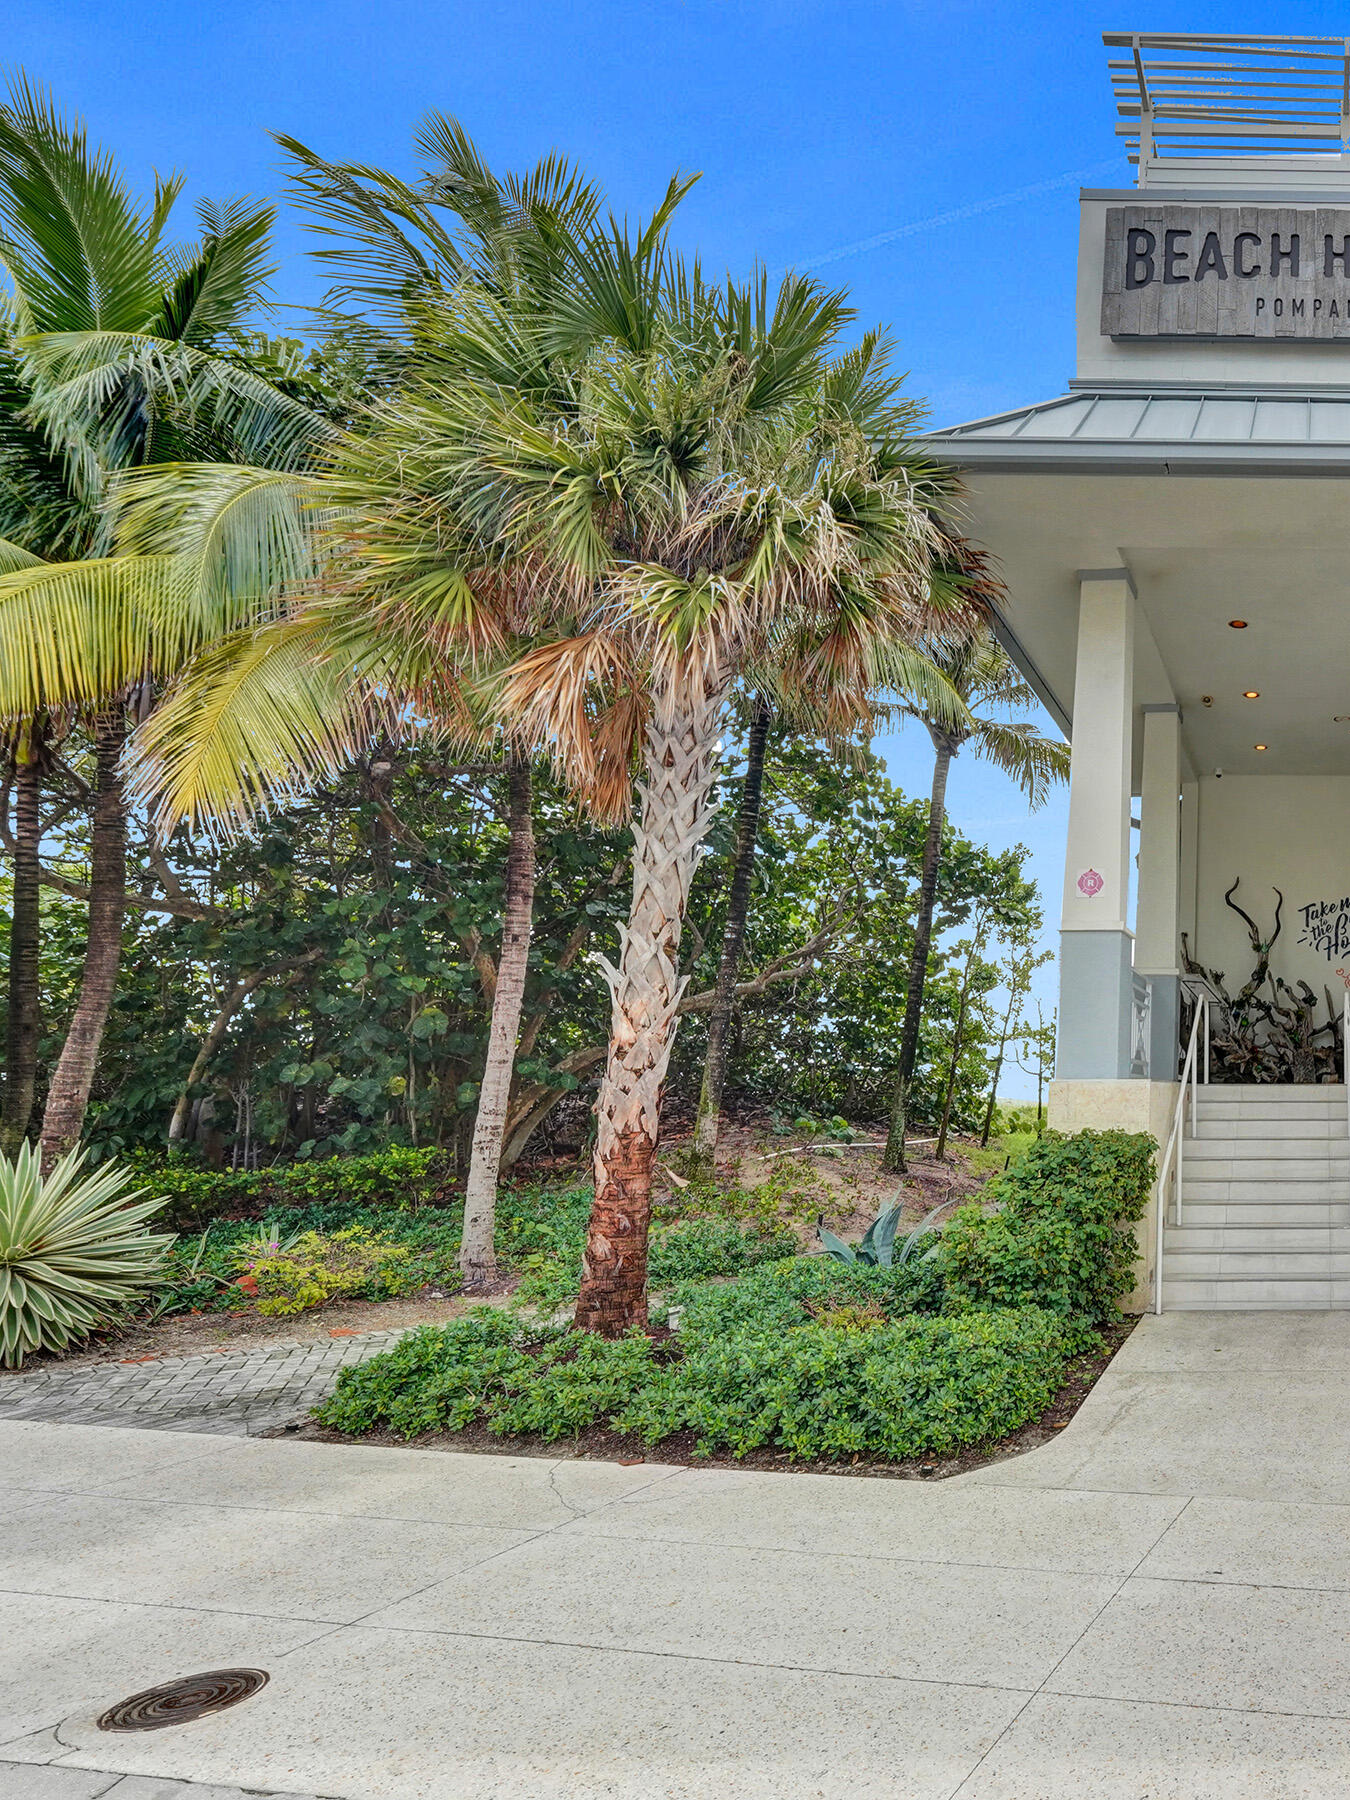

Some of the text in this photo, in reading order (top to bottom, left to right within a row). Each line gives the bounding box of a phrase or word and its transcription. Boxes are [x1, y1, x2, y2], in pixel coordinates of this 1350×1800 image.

[1126, 228, 1300, 291] BEACH
[1297, 901, 1338, 927] Take
[1319, 918, 1328, 927] to
[1310, 923, 1333, 941] the
